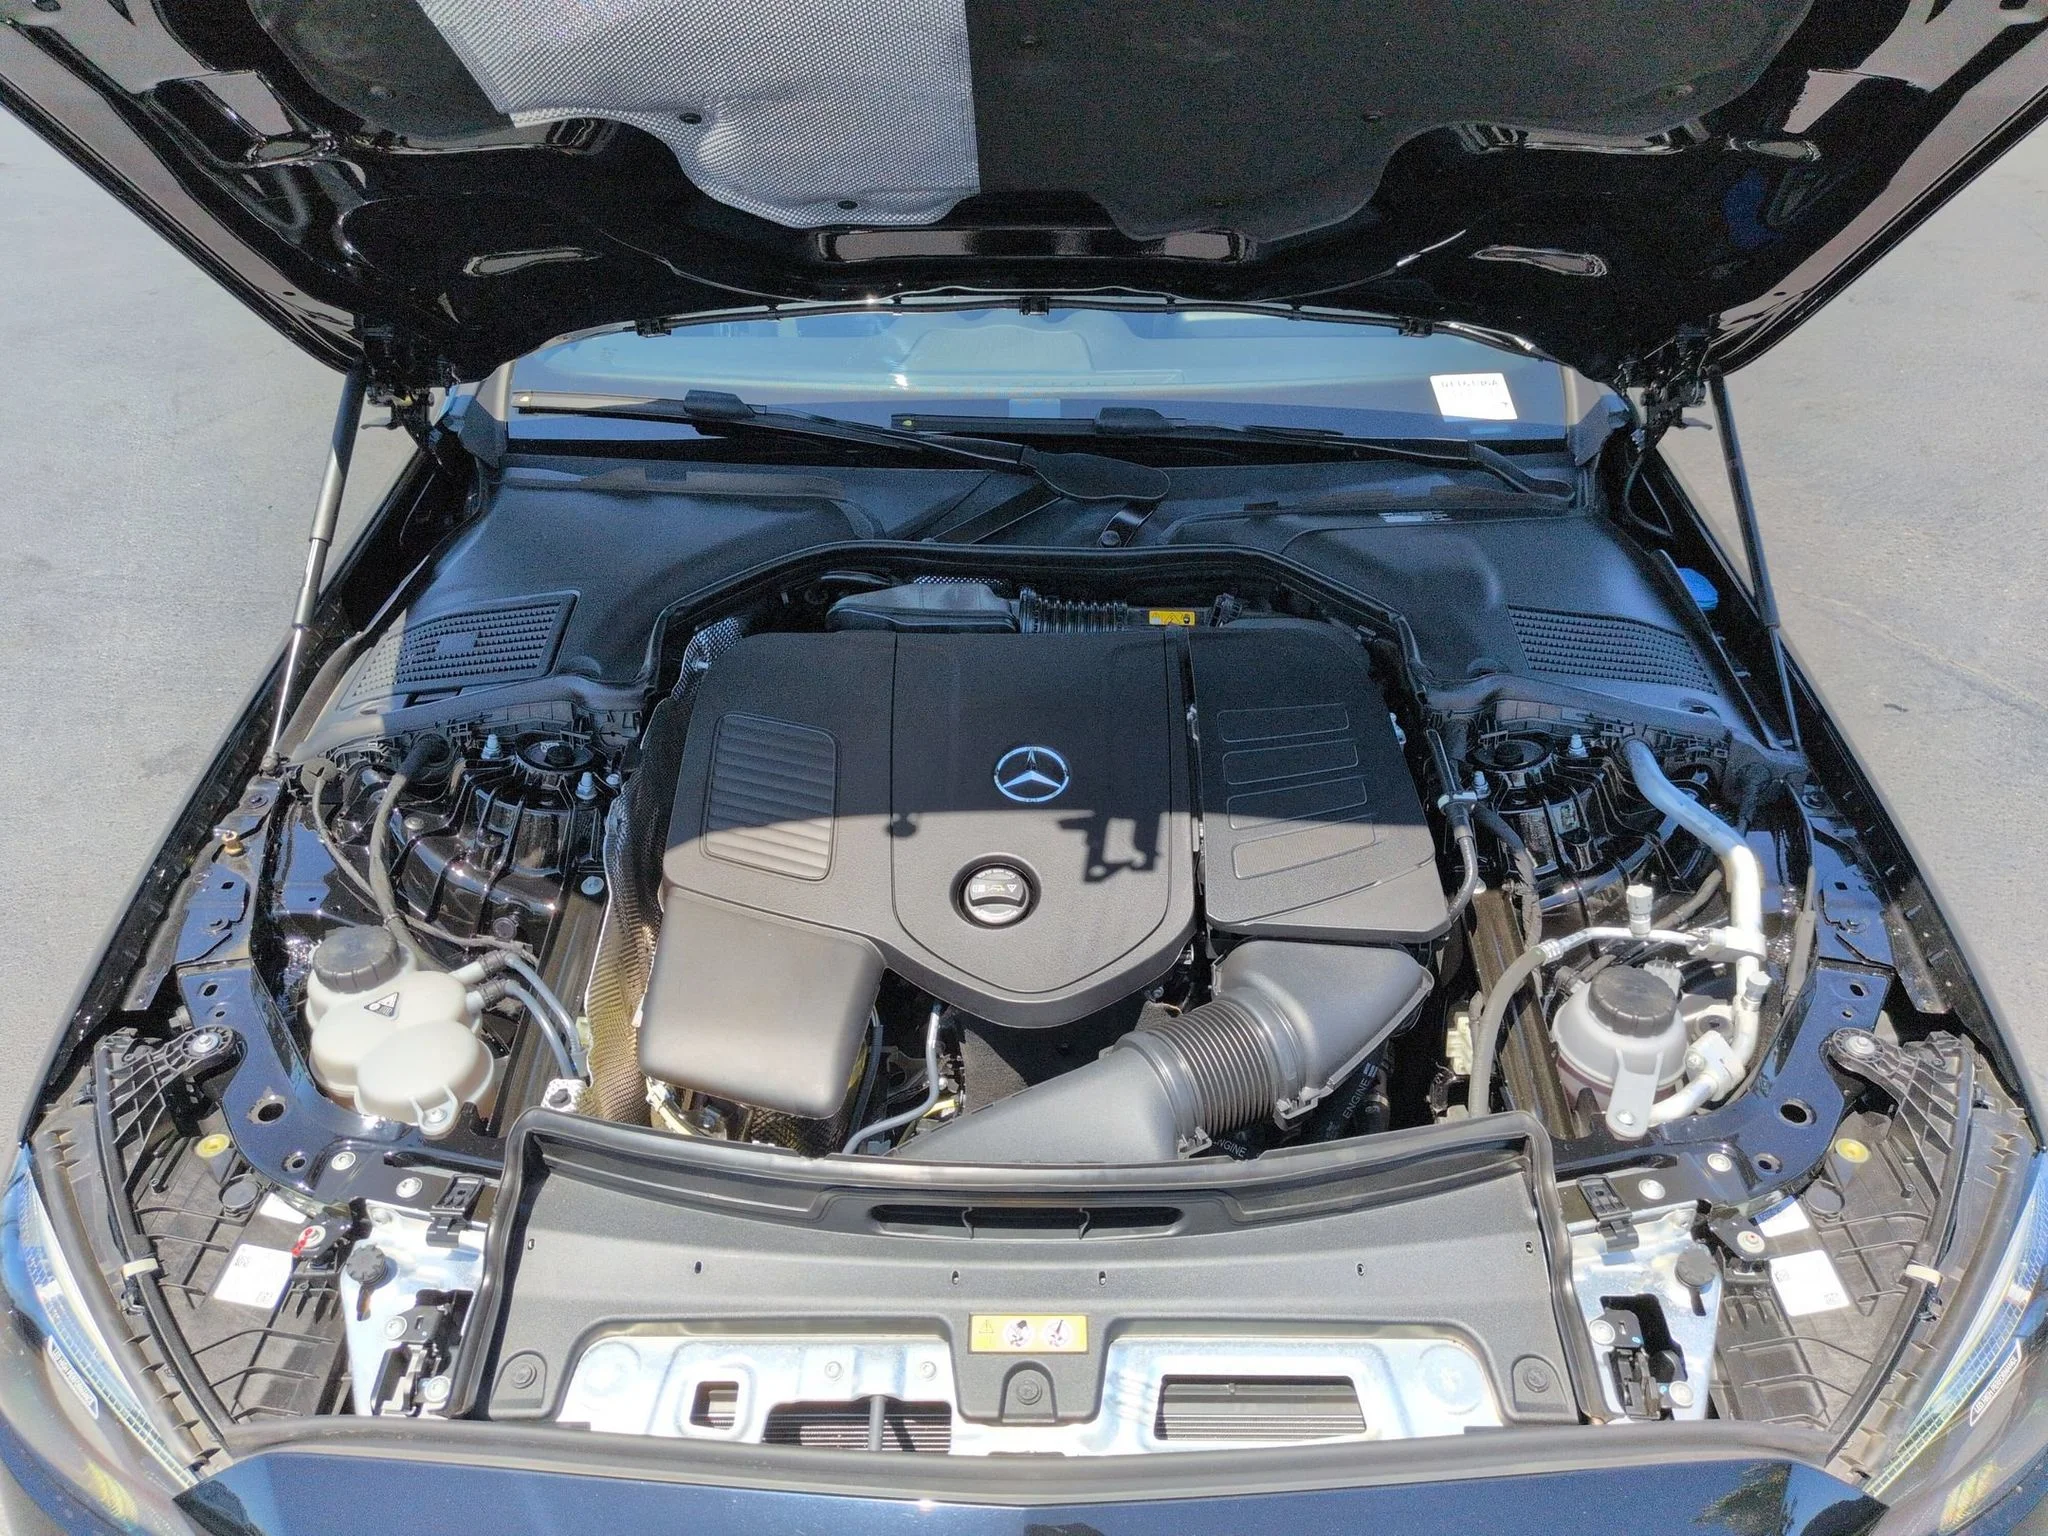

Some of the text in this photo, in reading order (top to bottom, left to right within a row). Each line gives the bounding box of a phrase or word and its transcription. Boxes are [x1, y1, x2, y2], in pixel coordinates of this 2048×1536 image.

[1342, 1078, 1371, 1119] ENGINE
[1213, 1139, 1248, 1158] NGINE
[1973, 1400, 1985, 1413] LED
[1990, 1355, 2018, 1392] PERFORMANCE
